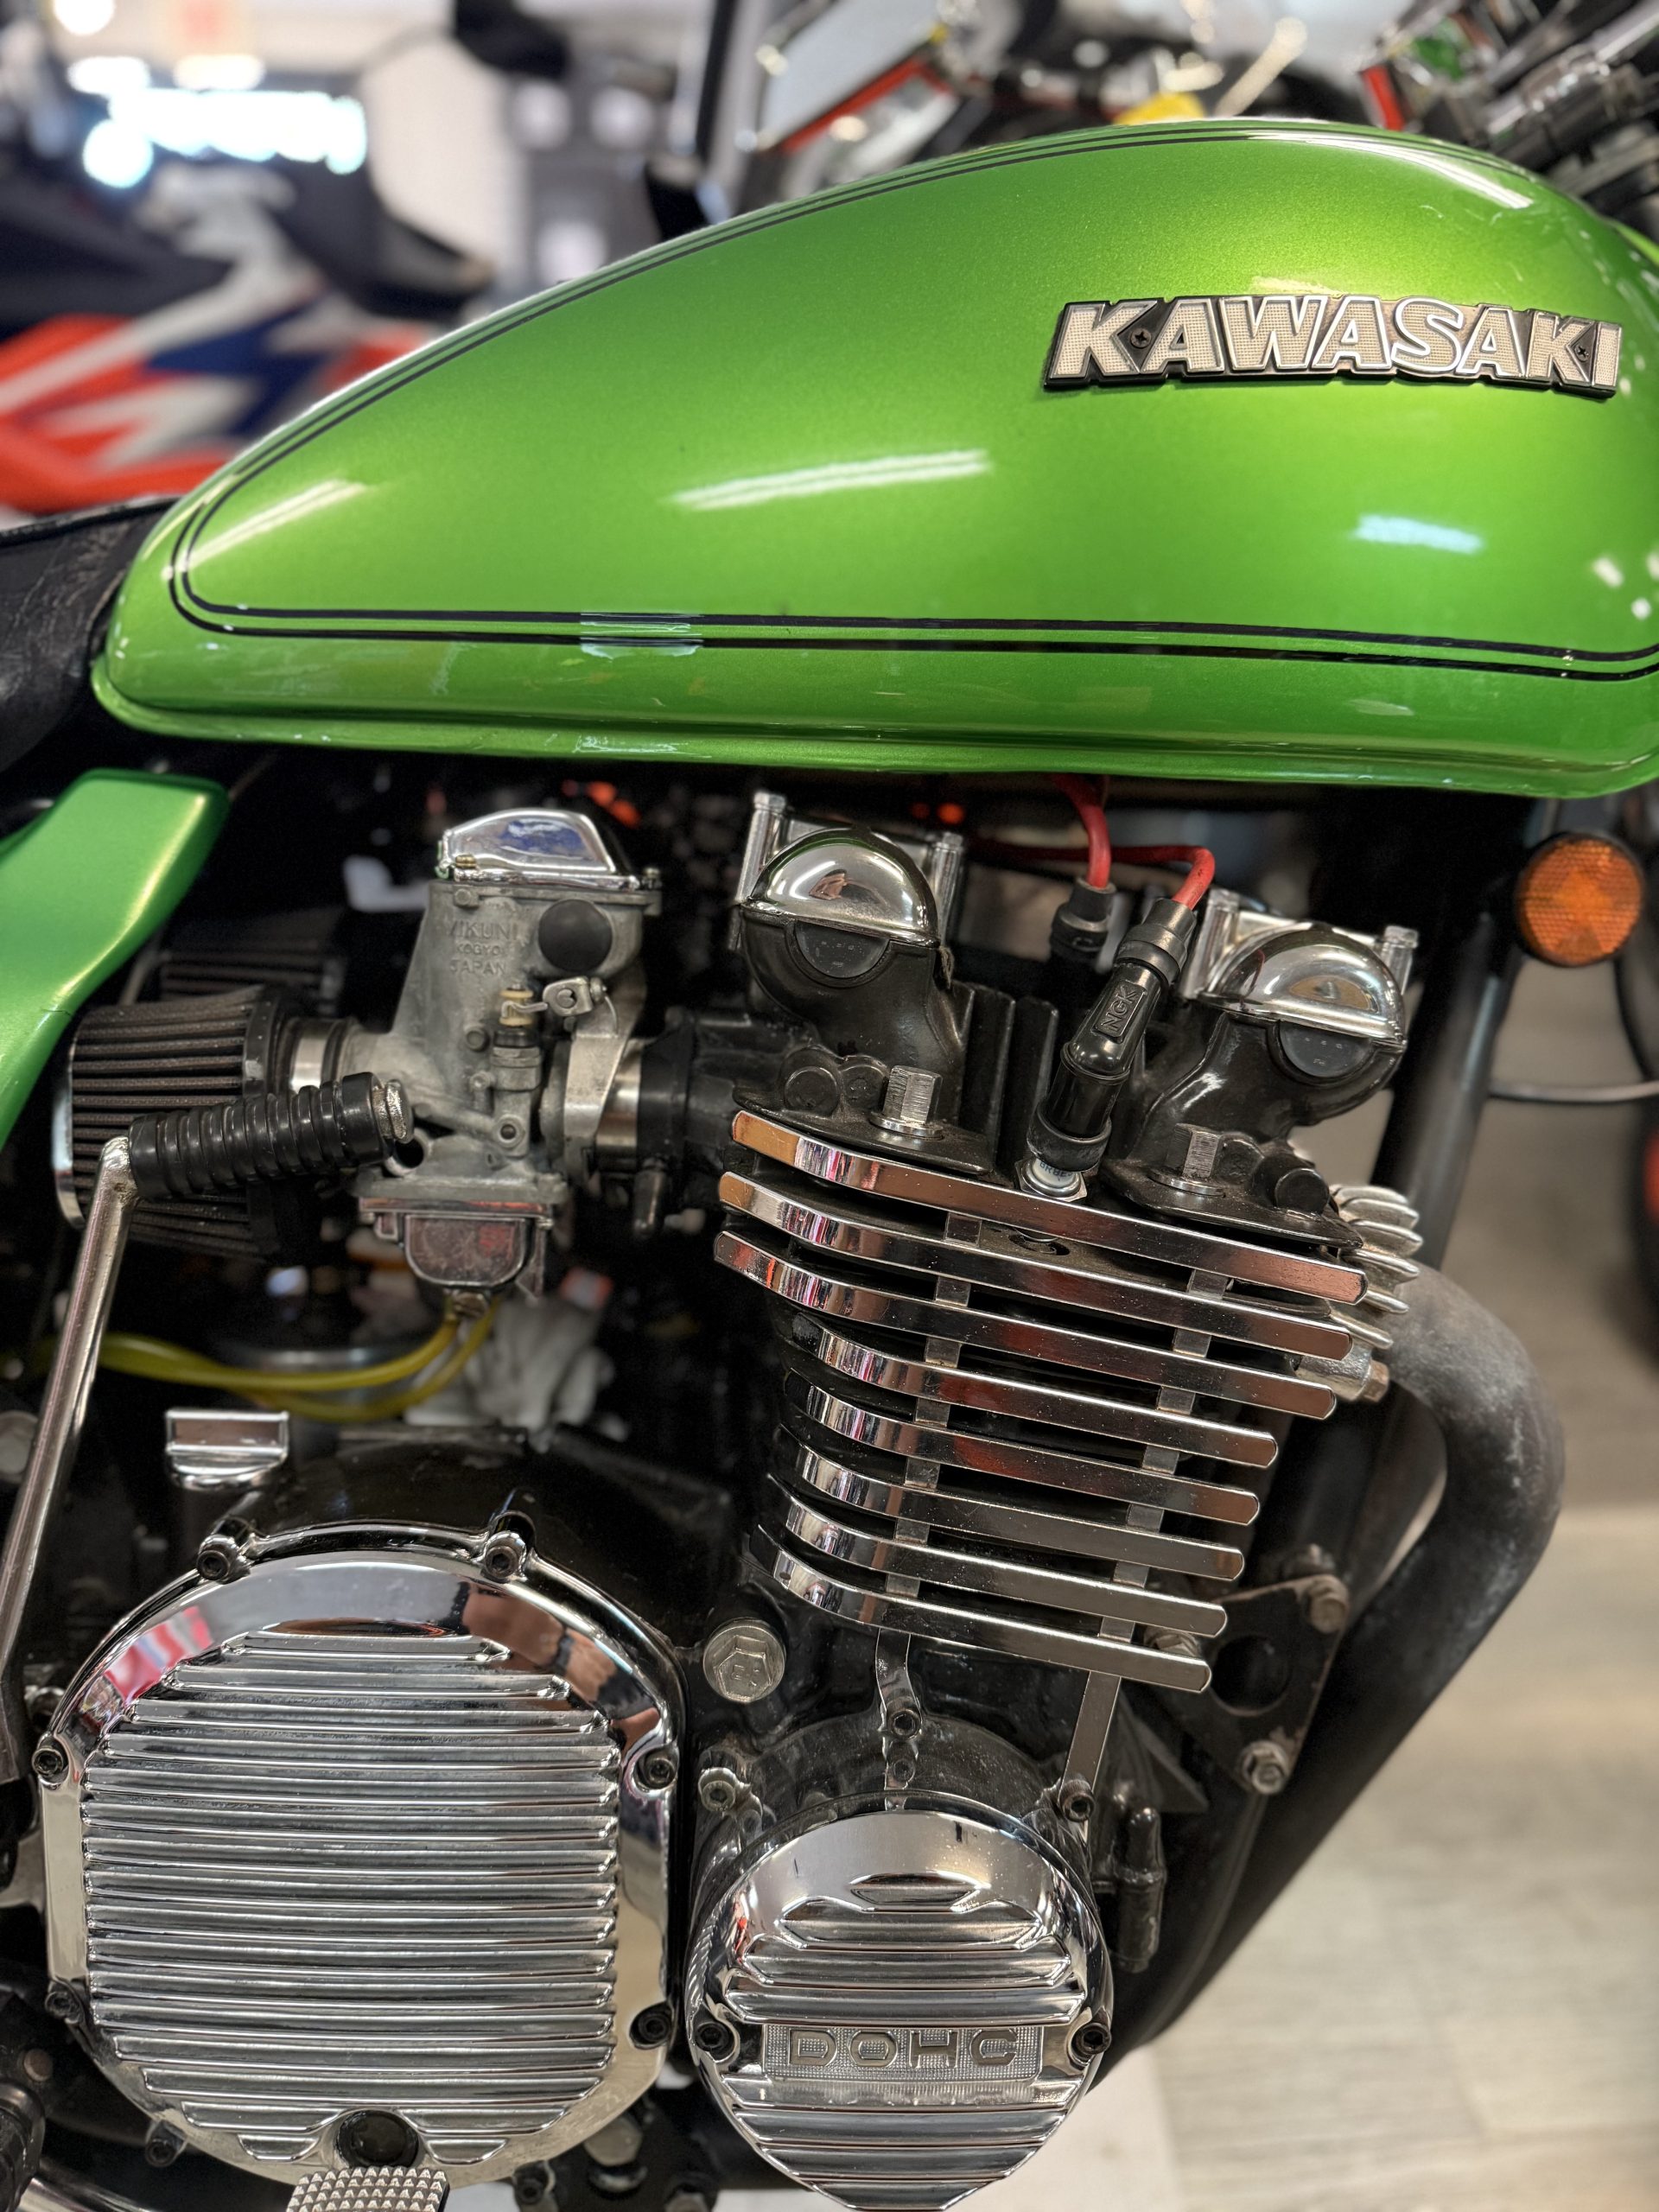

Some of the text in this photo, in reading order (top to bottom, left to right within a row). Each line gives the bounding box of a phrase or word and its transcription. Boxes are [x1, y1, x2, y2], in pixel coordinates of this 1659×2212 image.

[1050, 296, 1623, 388] KAWASAKI
[449, 958, 505, 975] JAPAN
[1100, 985, 1138, 1032] NGK
[787, 2028, 1019, 2069] DOHC
